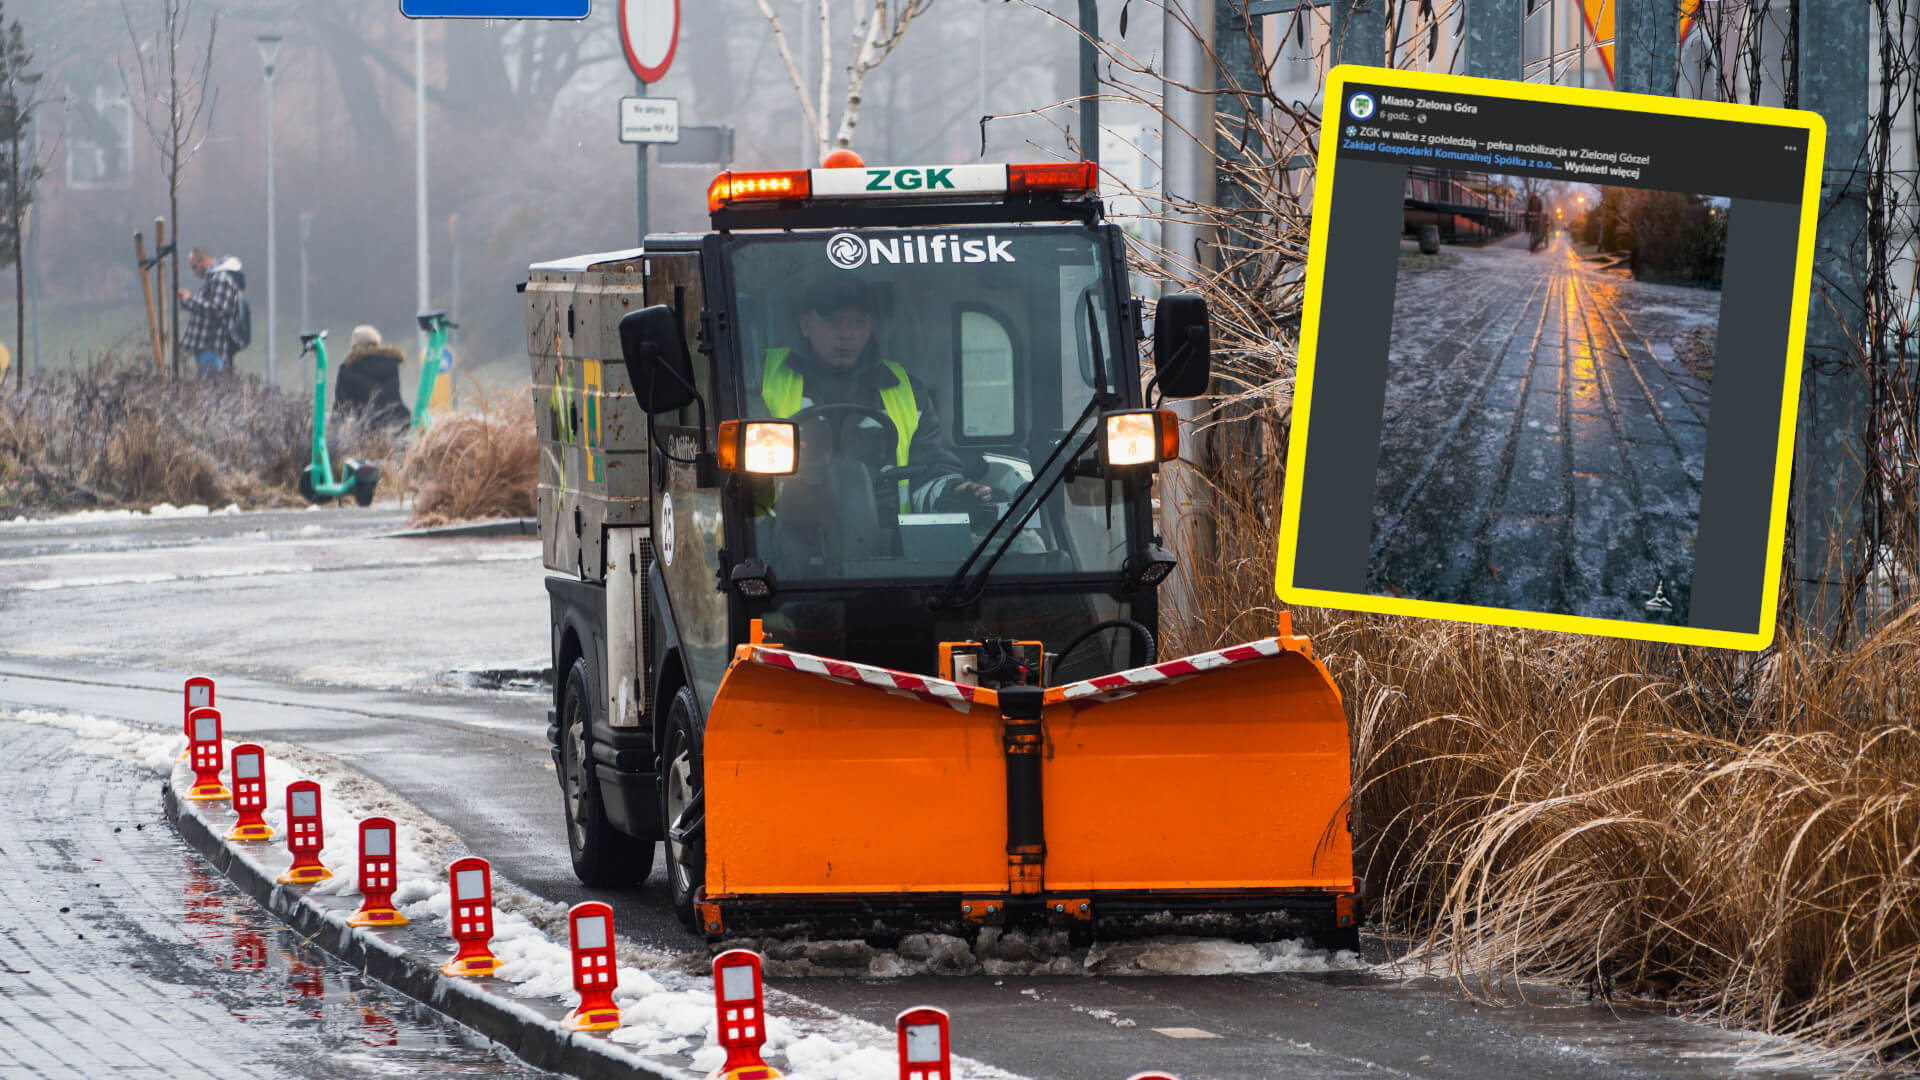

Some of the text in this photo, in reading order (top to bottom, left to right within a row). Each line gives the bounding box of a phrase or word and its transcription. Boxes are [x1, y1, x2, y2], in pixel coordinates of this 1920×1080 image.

[866, 168, 955, 190] ZGK
[869, 234, 1016, 265] Nilfisk
[675, 434, 698, 461] Nilfisk
